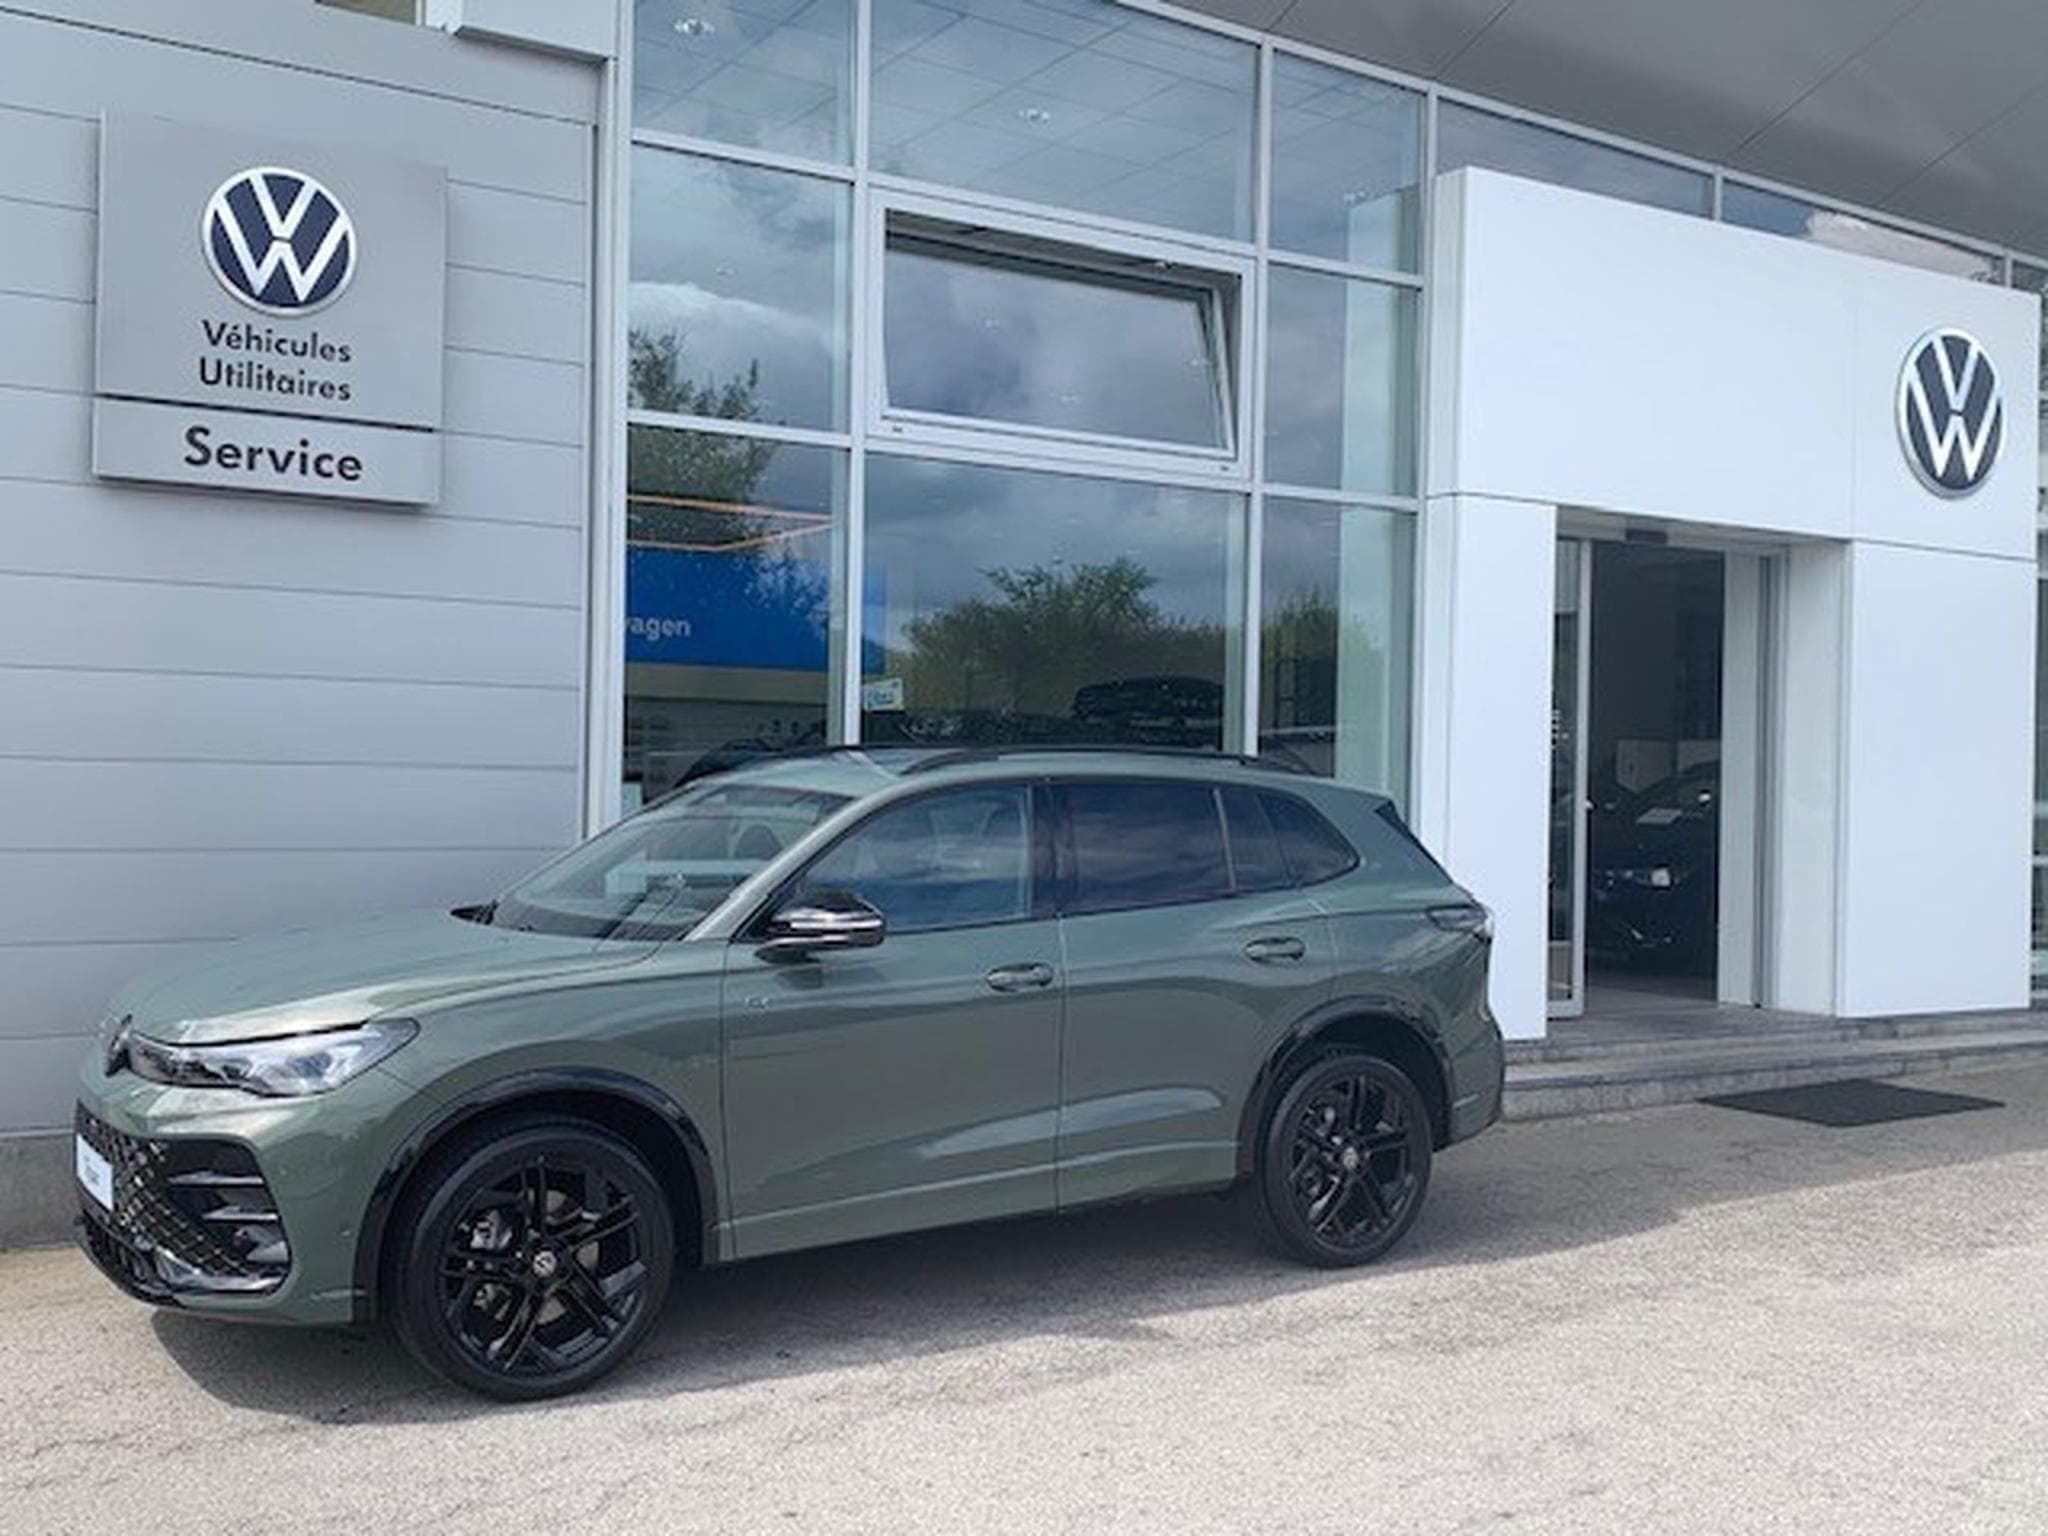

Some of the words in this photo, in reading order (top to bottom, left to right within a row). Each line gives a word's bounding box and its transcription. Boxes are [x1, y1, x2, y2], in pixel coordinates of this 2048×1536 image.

[205, 169, 354, 306] VW
[202, 319, 351, 363] Véhicules
[200, 356, 351, 401] Utilitaires
[1899, 330, 2005, 490] VW
[184, 425, 363, 481] Service
